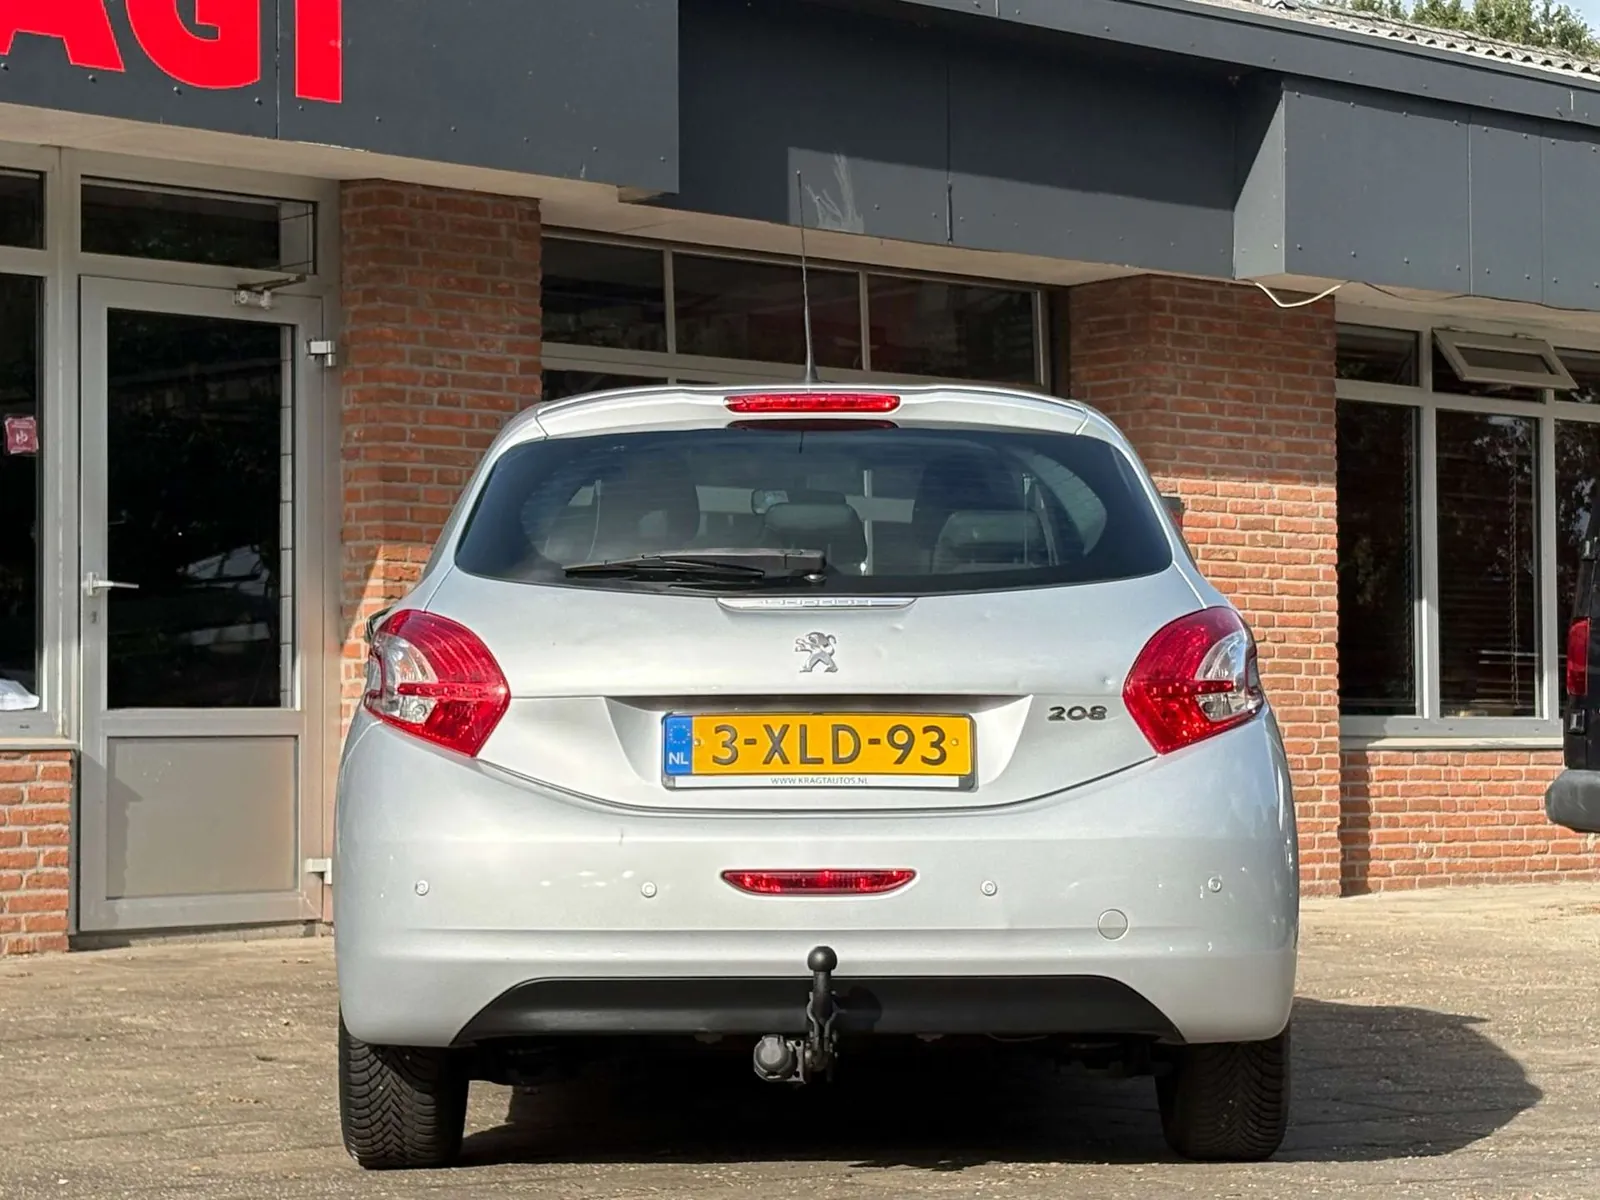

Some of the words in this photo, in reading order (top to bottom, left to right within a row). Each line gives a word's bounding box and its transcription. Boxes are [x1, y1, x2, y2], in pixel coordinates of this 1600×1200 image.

[1048, 705, 1108, 721] 208
[711, 723, 947, 766] 3-XLD-93
[668, 752, 689, 765] NL
[770, 776, 868, 785] WWW.KRAGTAUTOS.NL
